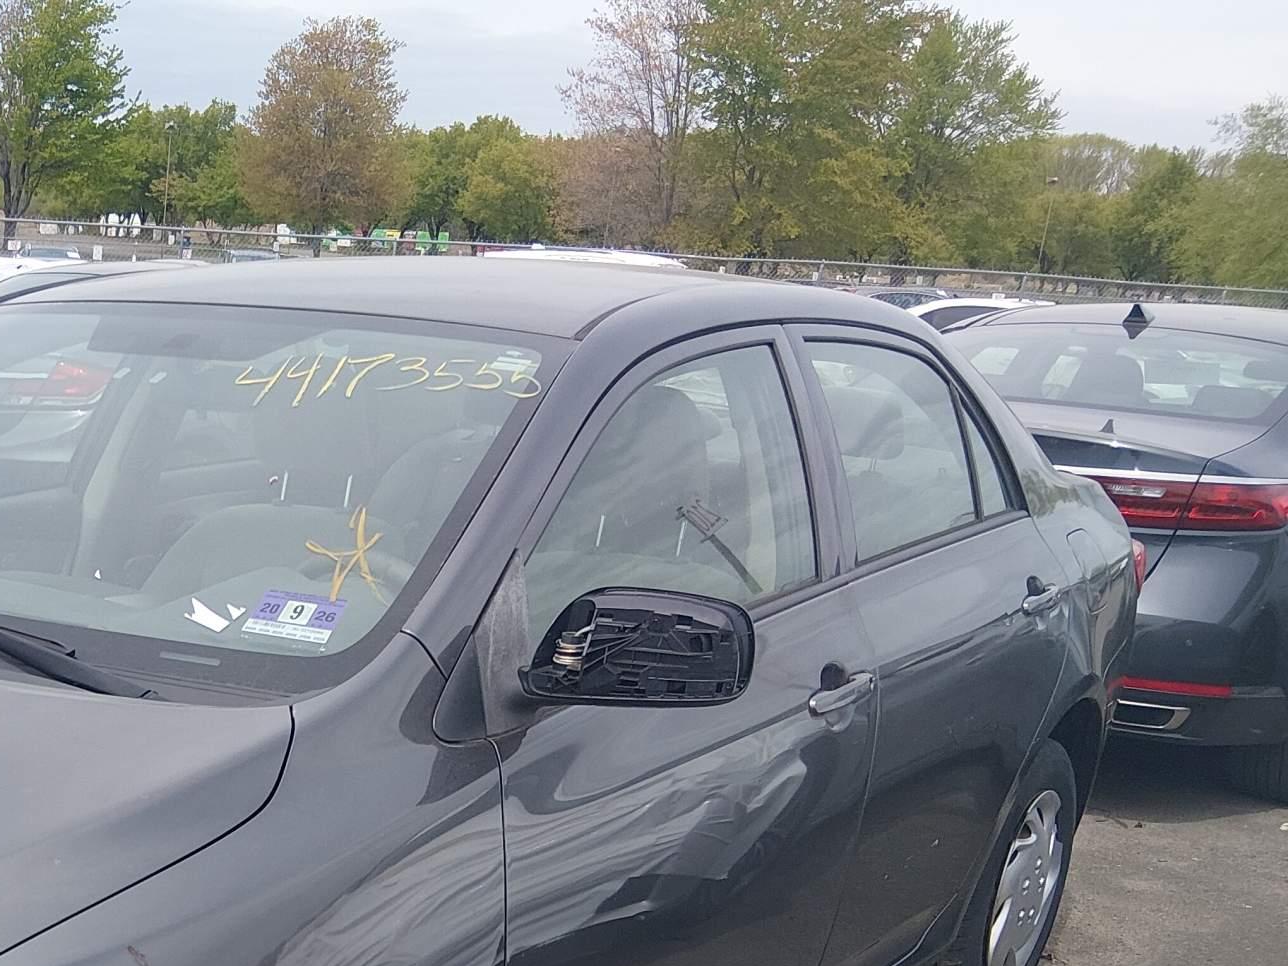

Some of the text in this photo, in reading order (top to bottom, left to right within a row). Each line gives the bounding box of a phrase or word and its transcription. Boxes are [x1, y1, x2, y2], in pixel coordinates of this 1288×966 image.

[234, 352, 542, 408] 44173555
[259, 602, 337, 623] 20 9 26
